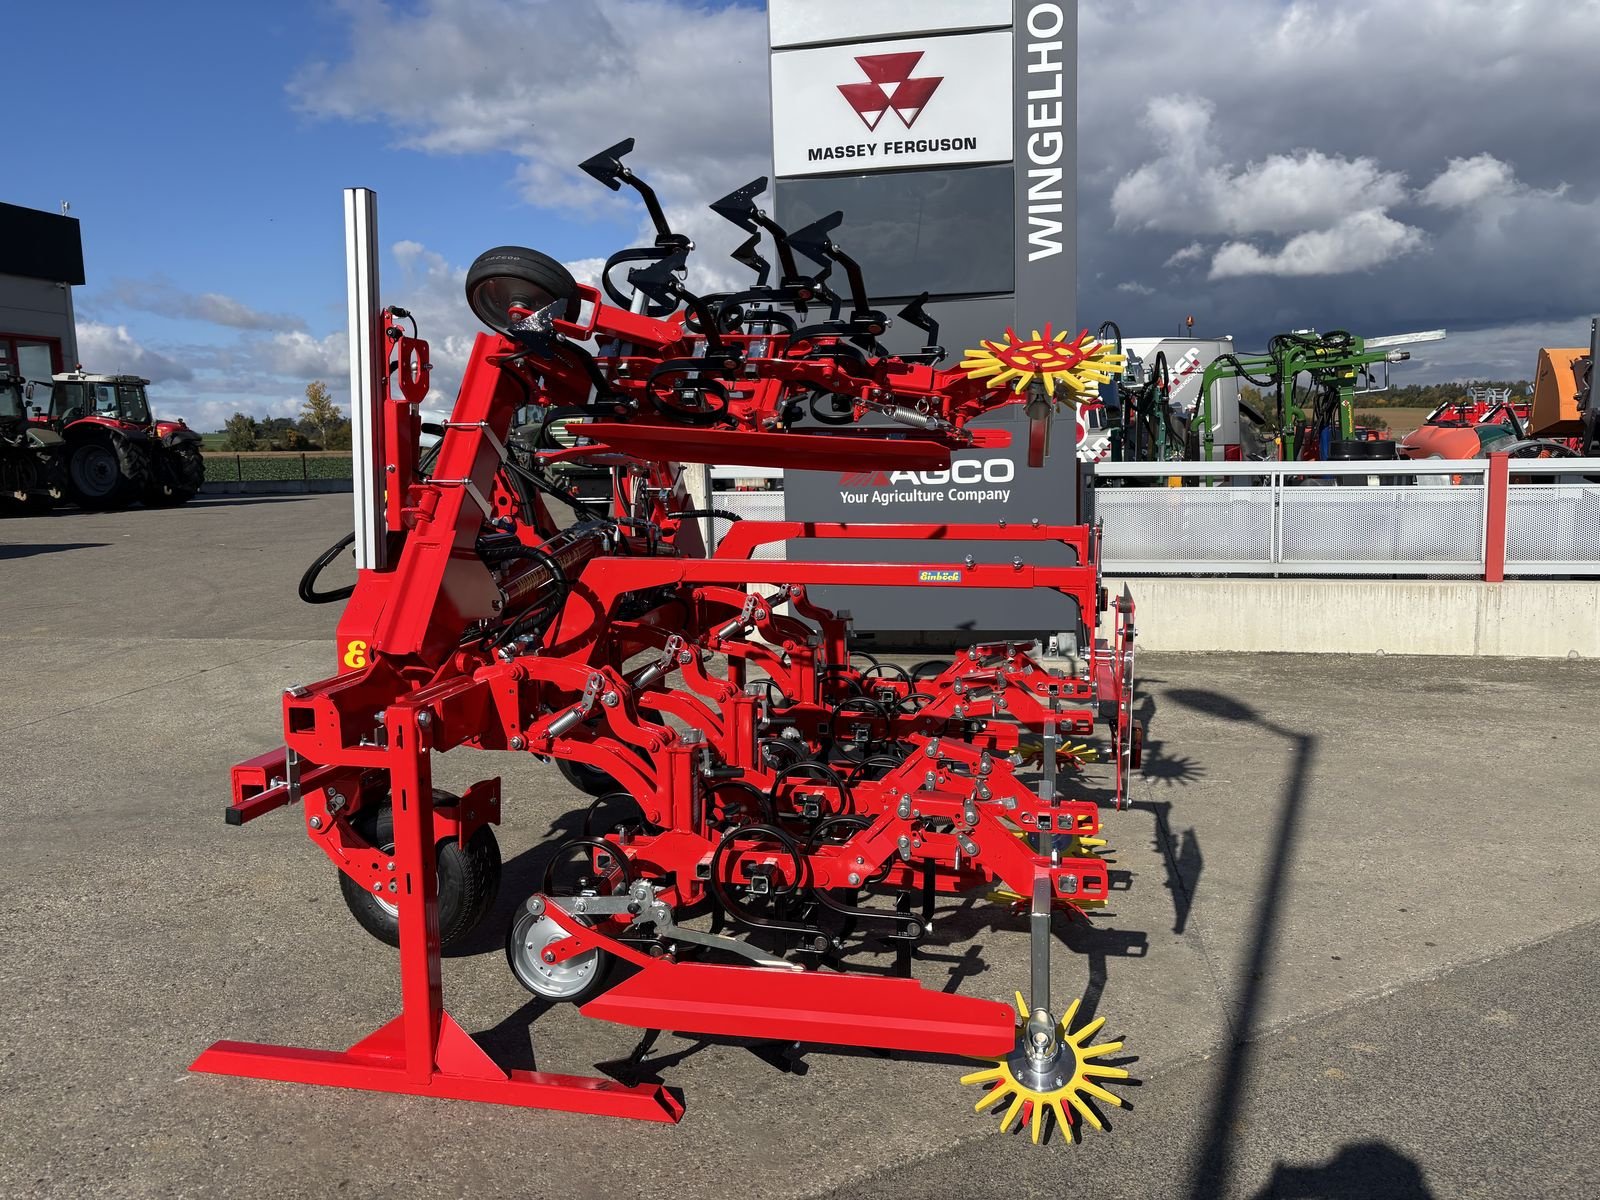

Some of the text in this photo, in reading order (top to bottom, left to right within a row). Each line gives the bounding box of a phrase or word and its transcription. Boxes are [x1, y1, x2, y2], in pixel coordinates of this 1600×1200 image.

[1027, 3, 1064, 262] WINGELHO
[808, 137, 977, 161] MASSEY FERGUSON
[840, 488, 1011, 506] Your Agriculture Company
[920, 571, 959, 581] Einböck
